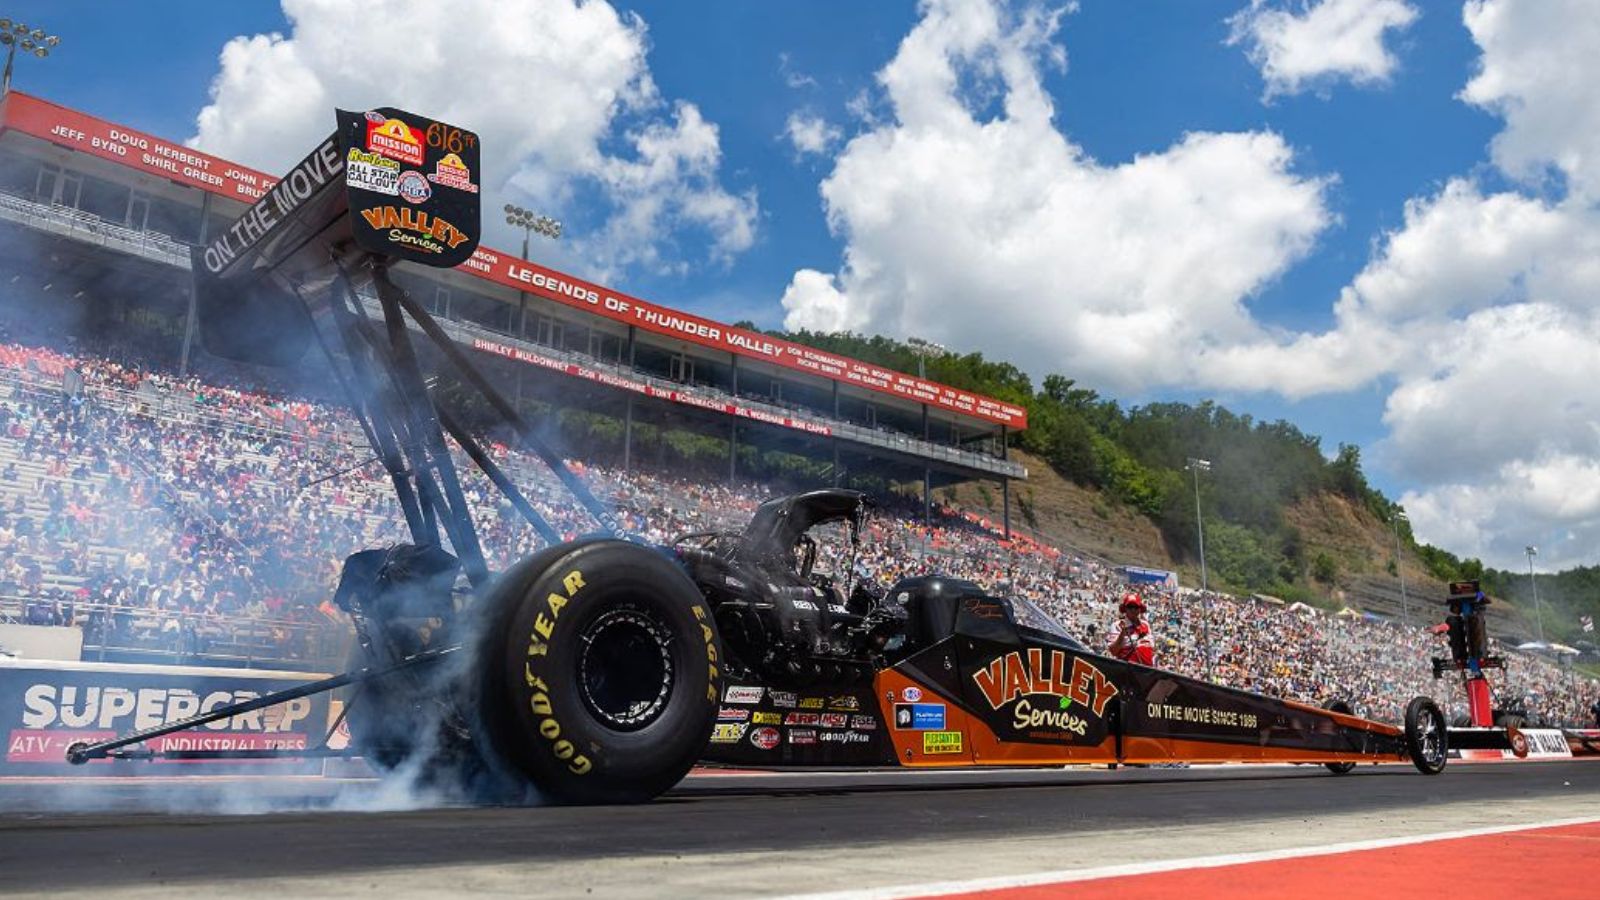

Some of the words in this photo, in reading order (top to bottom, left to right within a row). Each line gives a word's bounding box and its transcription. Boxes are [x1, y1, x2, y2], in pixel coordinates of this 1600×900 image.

[51, 125, 85, 142] JEFF
[91, 136, 127, 156] BYRD
[142, 153, 179, 173] SHIRL
[183, 166, 223, 187] GREER
[109, 129, 148, 149] DOUG
[154, 144, 212, 170] HERBERT
[224, 169, 257, 185] JOHN
[348, 172, 397, 190] CALLOUT
[371, 168, 398, 182] STAR
[204, 237, 236, 272] ON
[231, 198, 277, 247] THE
[272, 140, 344, 217] MOVE
[361, 206, 470, 249] VALLEY
[388, 228, 444, 254] Services
[472, 250, 498, 264] NSON
[507, 264, 599, 305] LEGENDS
[604, 296, 630, 313] OF
[634, 306, 721, 341] THUNDER
[725, 331, 783, 357] VALLEY
[474, 339, 512, 357] SHIRLEY
[516, 350, 569, 372] MULDOWNEY
[578, 368, 595, 379] DON
[651, 388, 671, 398] TONY
[735, 407, 749, 417] DEL
[691, 605, 718, 704] EAGLE
[525, 570, 592, 775] GOODYEAR
[973, 648, 1119, 718] VALLEY
[1013, 699, 1088, 736] Services
[1147, 703, 1161, 718] ON
[1163, 705, 1182, 720] THE
[1184, 707, 1211, 723] MOVE
[1211, 709, 1238, 726] SINCE
[10, 736, 51, 753] ATV
[162, 738, 255, 752] INDUSTRIAL
[820, 731, 869, 744] GOODYEAR
